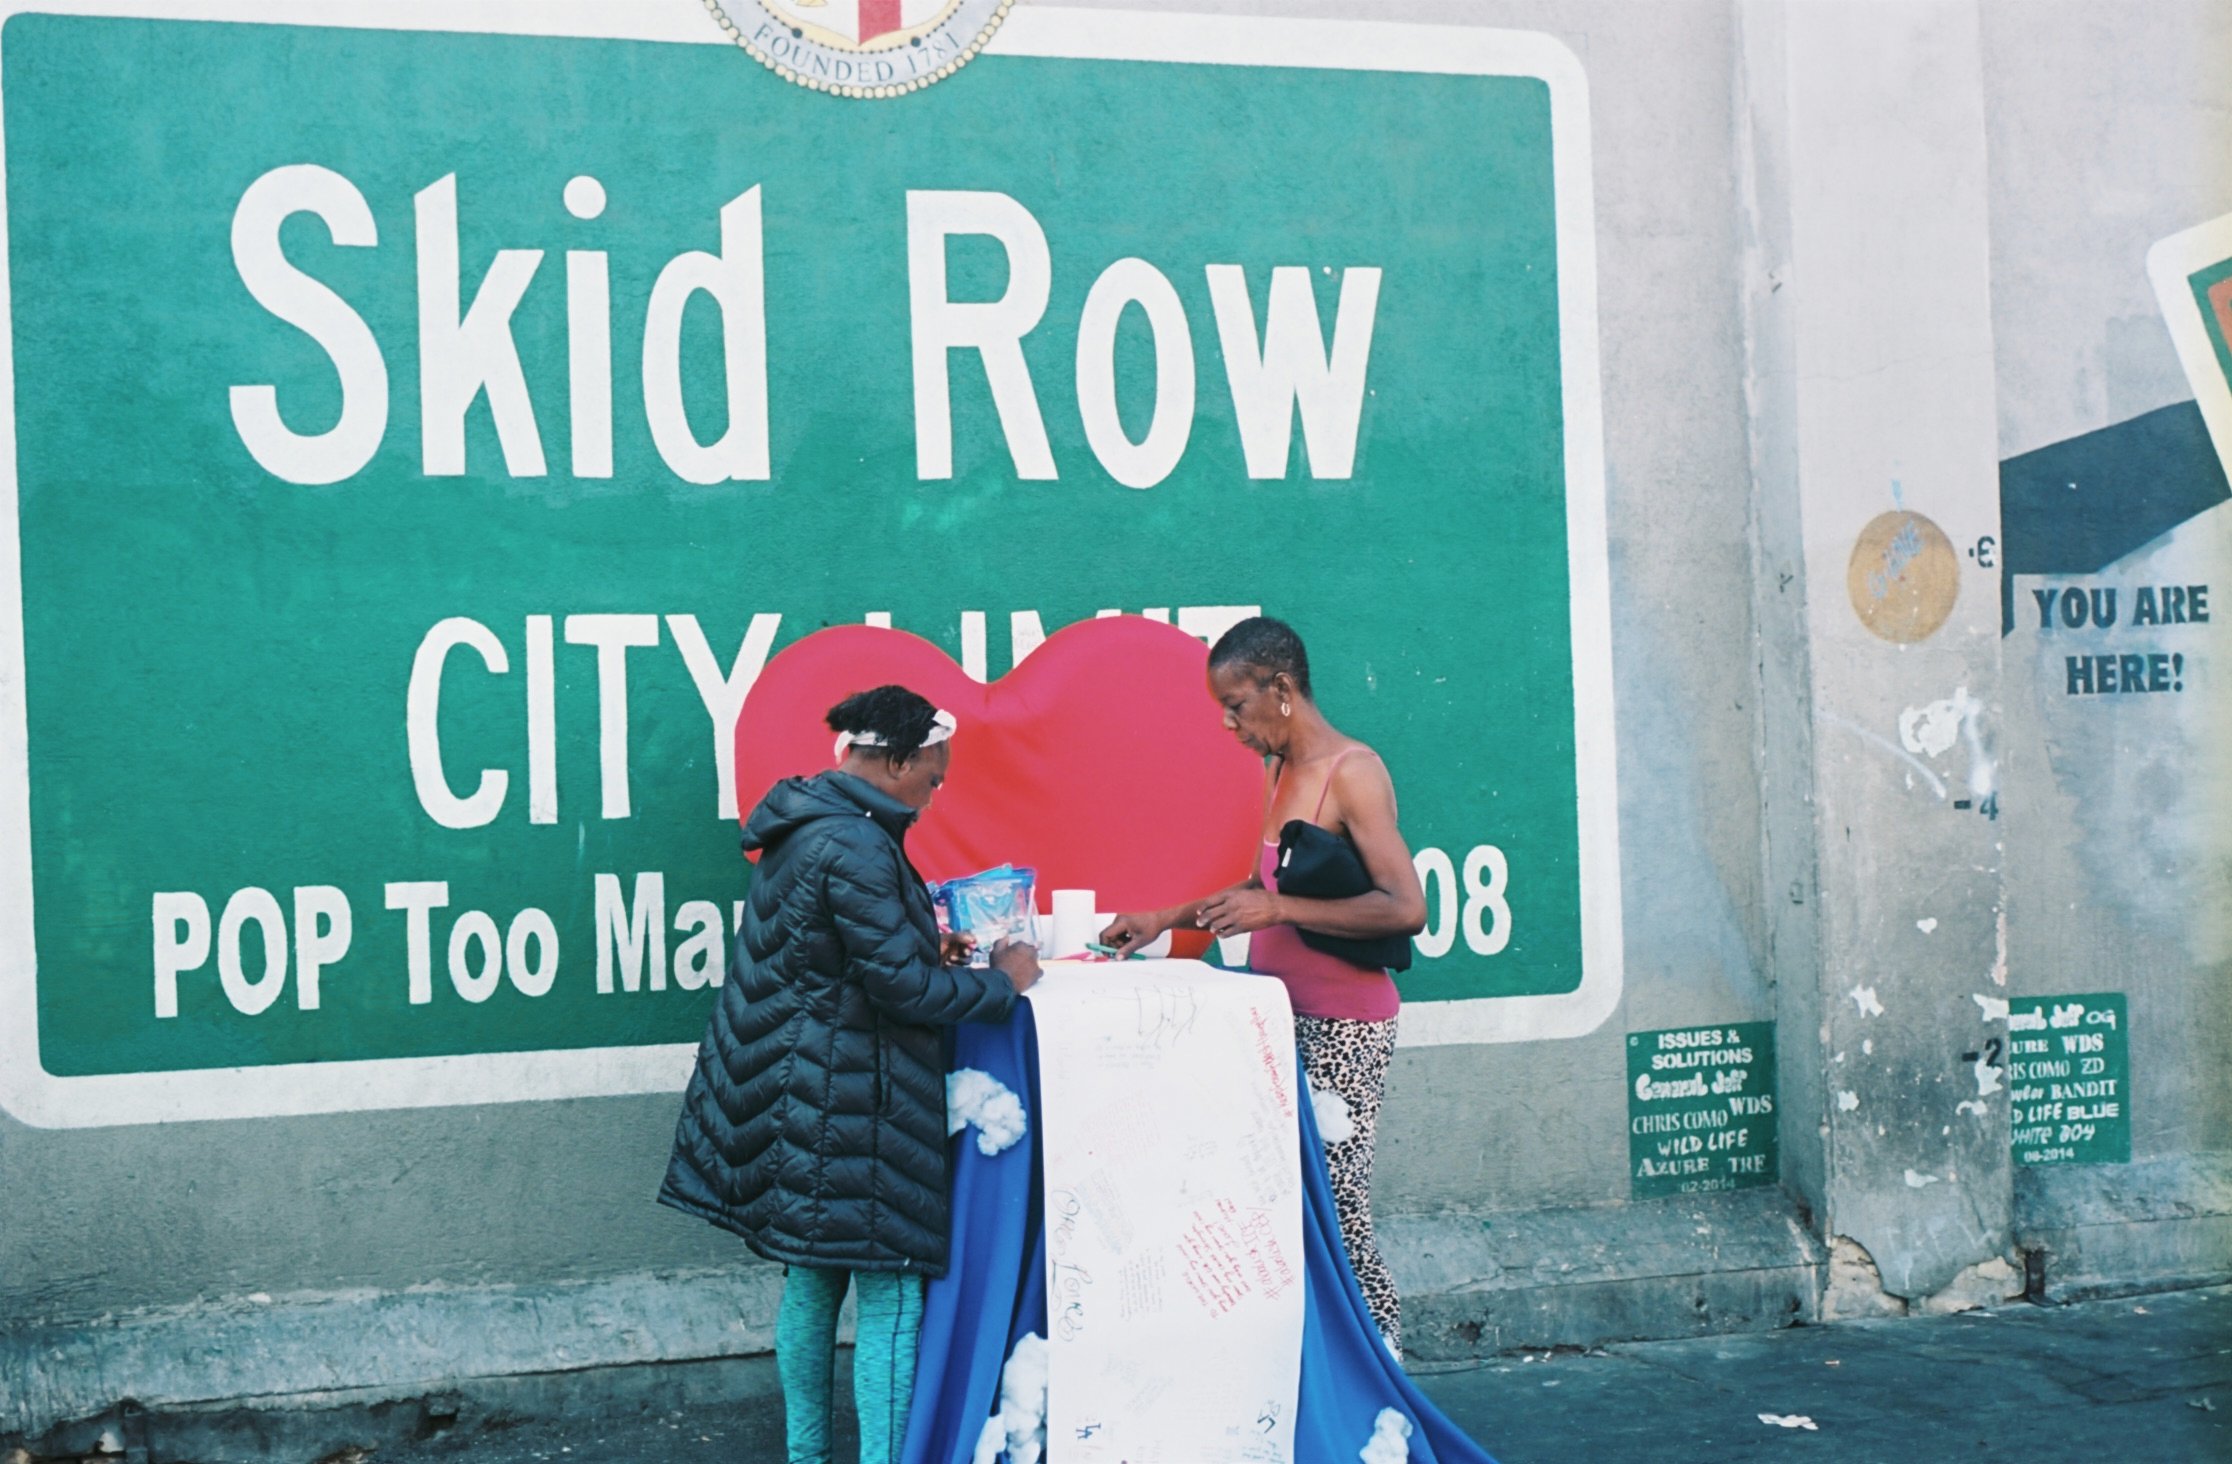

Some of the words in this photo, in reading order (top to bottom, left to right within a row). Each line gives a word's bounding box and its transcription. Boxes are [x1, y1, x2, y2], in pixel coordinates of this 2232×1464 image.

[754, 23, 894, 83] FOUNDED
[906, 31, 960, 74] 1781
[229, 163, 770, 485] Skid
[906, 190, 1382, 489] Row
[2032, 586, 2117, 629] YOU
[2131, 585, 2210, 626] ARE
[2065, 652, 2183, 695] HERE!
[406, 613, 782, 829] CITY
[152, 885, 352, 1018] POP
[385, 881, 559, 1005] Too
[595, 871, 745, 994] Ma
[1658, 1029, 1722, 1050] ISSUES
[1727, 1029, 1740, 1044] &
[2010, 1039, 2049, 1055] URE
[2061, 1033, 2104, 1056] WDS
[1652, 1048, 1753, 1070] SOLUTIONS
[2029, 1060, 2070, 1079] COMO
[2051, 1079, 2118, 1100] BANDIT
[1728, 1094, 1773, 1116] WDS
[2028, 1102, 2063, 1123] LIFE
[2067, 1102, 2119, 1121] BLUE
[1632, 1112, 1680, 1135] CHRIS
[1683, 1109, 1728, 1129] COMO
[1657, 1135, 1703, 1157] WILD
[1708, 1128, 1748, 1151] LIFE
[1636, 1156, 1710, 1178] AZURE
